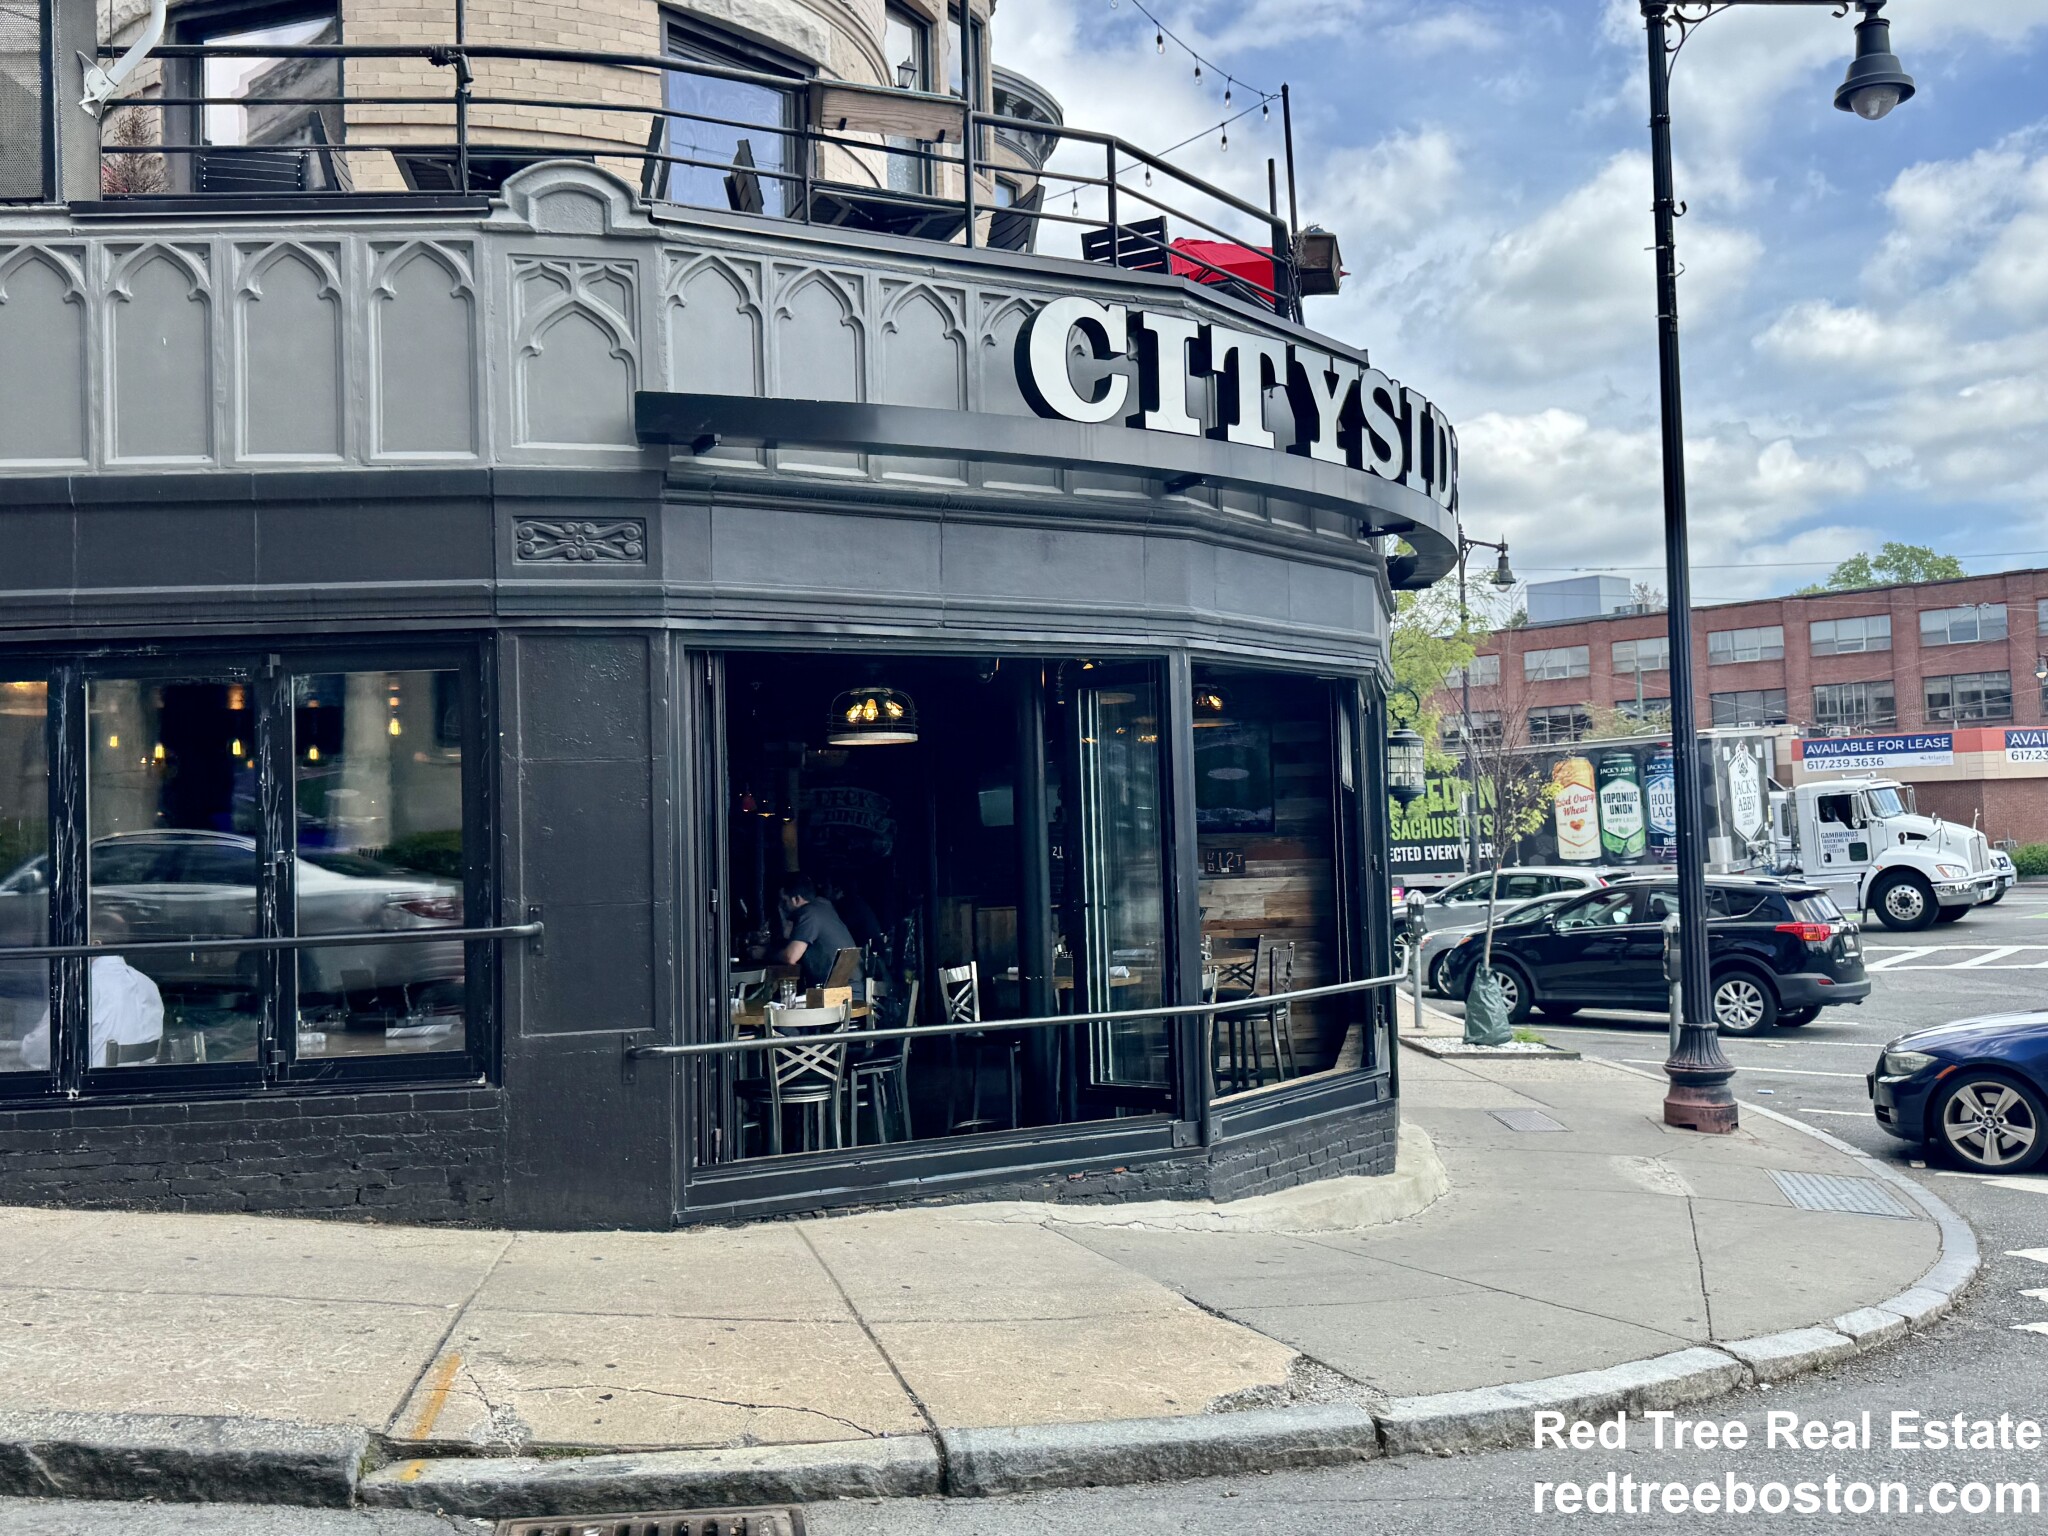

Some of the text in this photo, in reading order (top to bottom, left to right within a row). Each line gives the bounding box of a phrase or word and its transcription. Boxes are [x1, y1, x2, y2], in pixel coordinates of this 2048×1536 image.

[1018, 297, 1458, 513] CITYSID
[2011, 731, 2048, 746] AVAI
[1806, 737, 1950, 755] AVAILABLE FOR LEASE
[1806, 756, 1884, 770] 617.239.3636
[1563, 804, 1588, 816] Wheat
[1610, 804, 1633, 815] UNION
